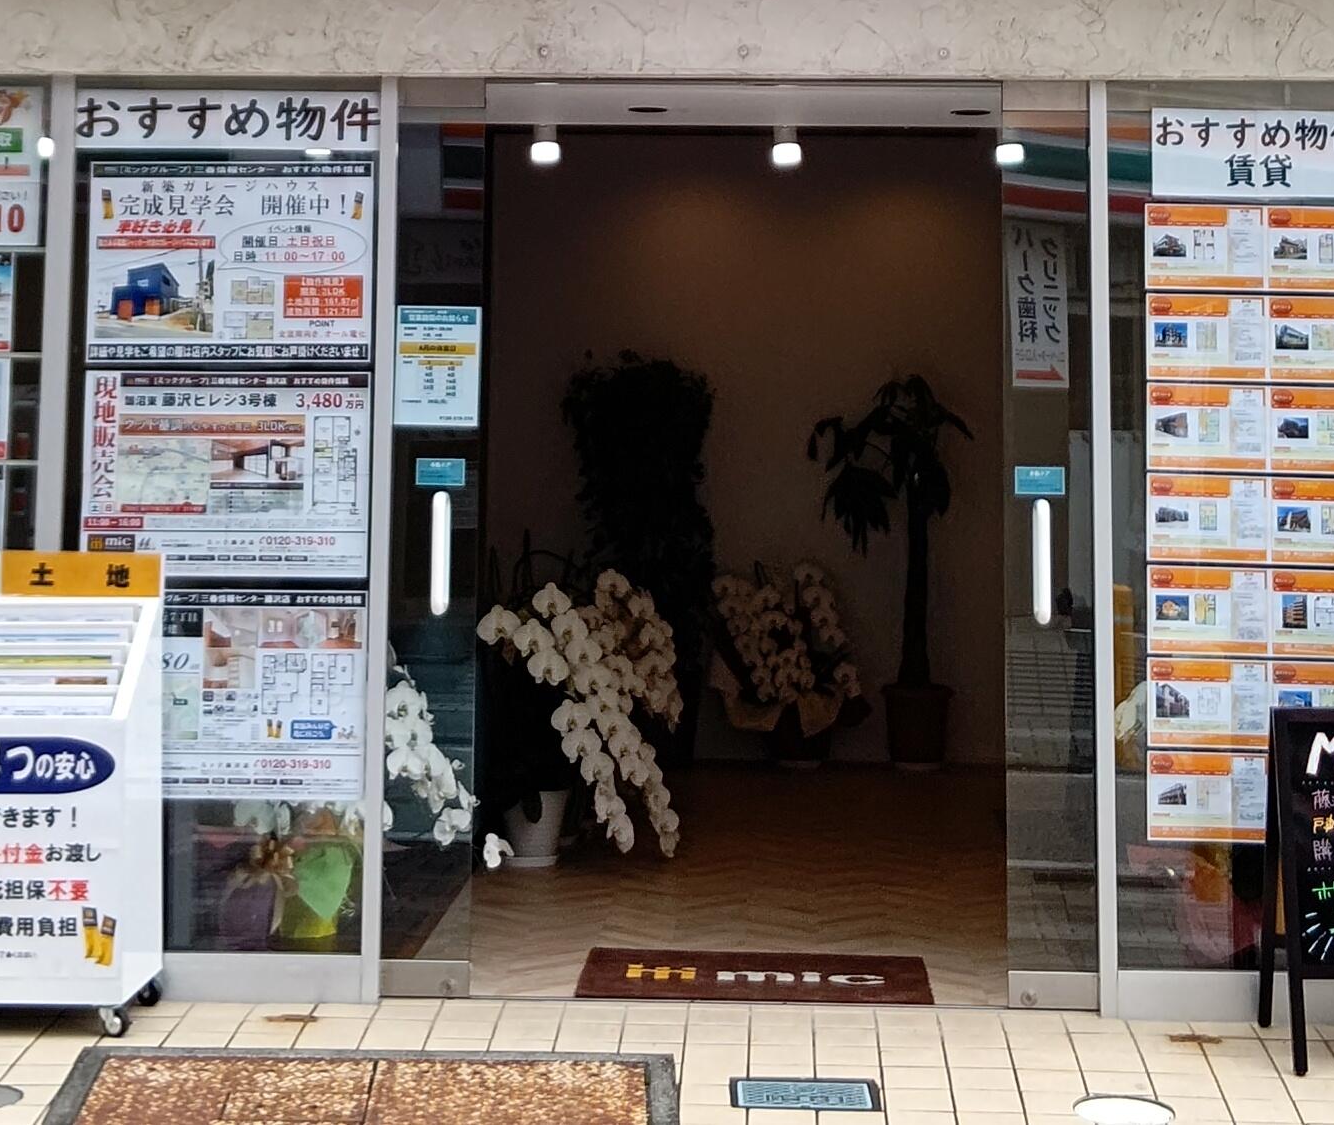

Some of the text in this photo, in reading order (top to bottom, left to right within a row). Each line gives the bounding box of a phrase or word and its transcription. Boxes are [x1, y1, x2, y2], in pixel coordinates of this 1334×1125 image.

[75, 96, 382, 143] おすすめ物件
[1223, 153, 1293, 188] 賃貸
[118, 194, 236, 217] 完成見学会
[308, 319, 335, 327] POINT
[295, 392, 344, 410] 3,480
[345, 399, 365, 410] 万円
[91, 375, 118, 500] 現地販売会
[105, 535, 132, 547] mic
[265, 535, 337, 546] 0120-319-310
[261, 759, 332, 769] 0120-319-310
[715, 970, 885, 986] mic
